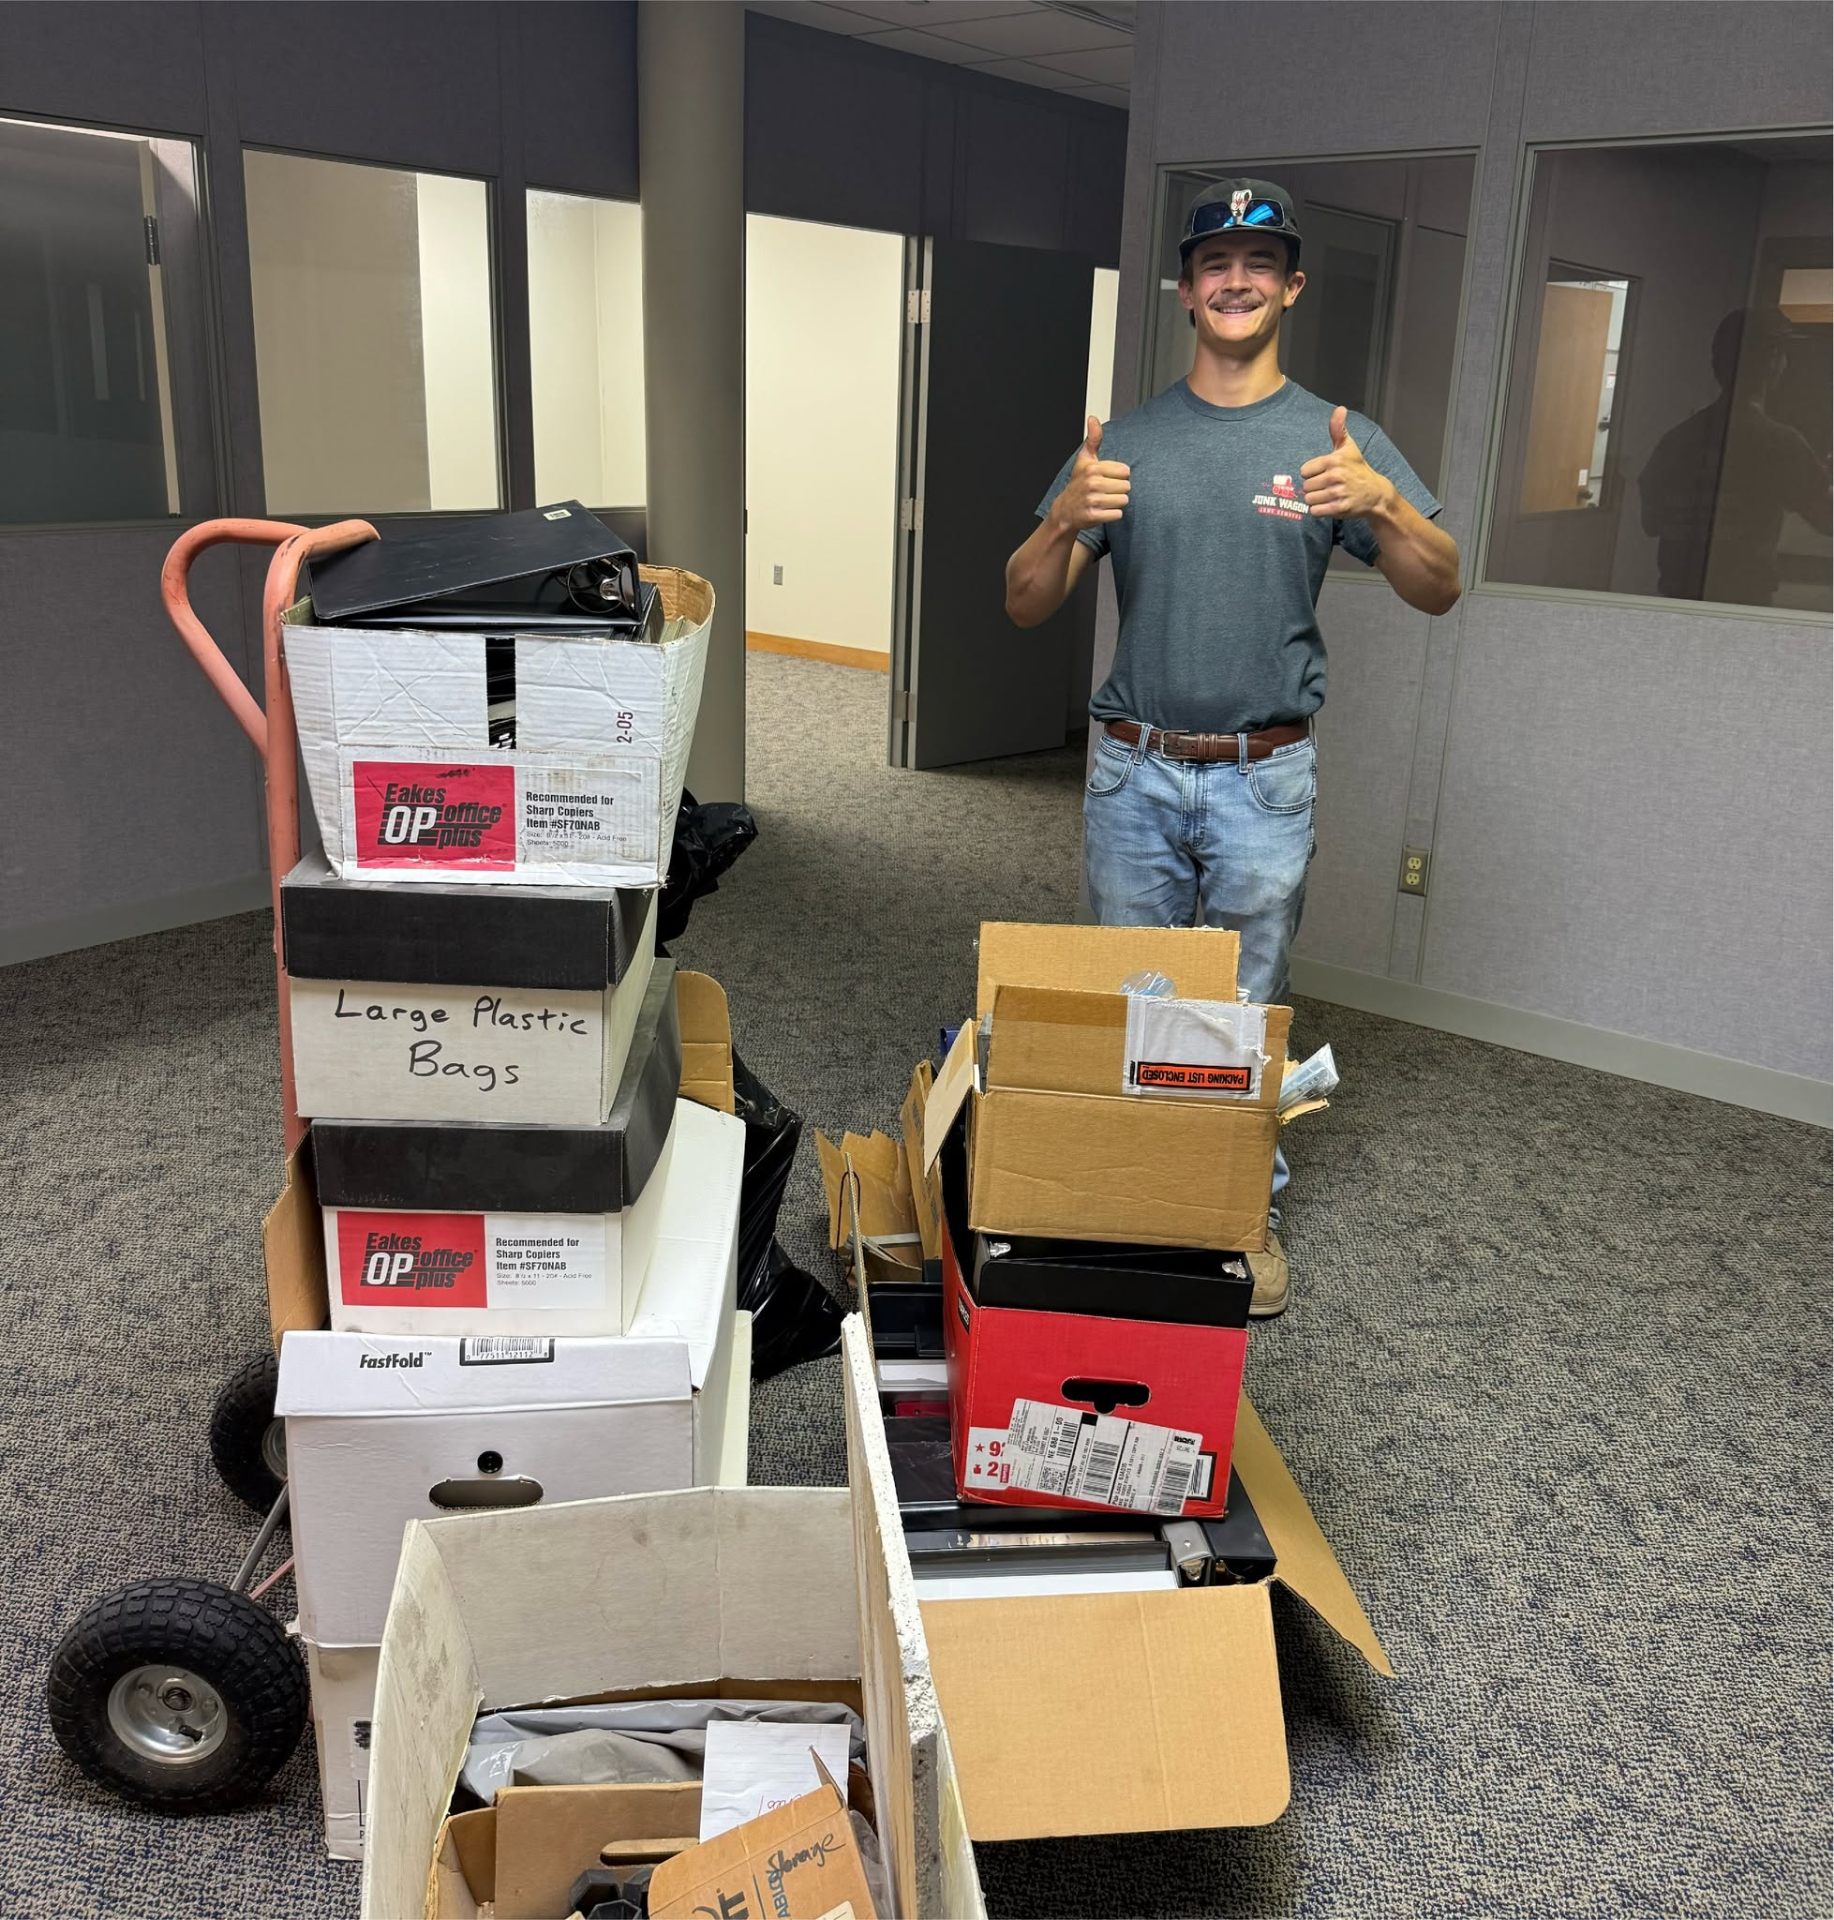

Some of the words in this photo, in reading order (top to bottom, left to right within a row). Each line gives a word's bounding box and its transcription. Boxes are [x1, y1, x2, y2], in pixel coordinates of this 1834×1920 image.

[1252, 495, 1277, 506] JUNK
[1279, 498, 1310, 514] WAGON
[616, 711, 634, 744] 2-05
[384, 783, 447, 804] Eakes
[526, 792, 598, 805] Recommended
[601, 795, 614, 806] for
[526, 805, 555, 817] Sharp
[558, 806, 594, 818] Copiers
[384, 805, 438, 844] OP
[443, 802, 503, 824] office
[526, 818, 548, 829] Item
[551, 820, 600, 831] #SF70NAB
[438, 828, 483, 850] plus
[334, 989, 450, 1033] Large
[472, 995, 588, 1035] Plastic
[409, 1039, 520, 1092] Bags
[1142, 1069, 1185, 1083] ENCLOSED
[1187, 1071, 1205, 1083] LIST
[1207, 1073, 1244, 1085] PACKING
[366, 1232, 423, 1250] Eakes
[496, 1237, 564, 1247] Recommended
[567, 1237, 580, 1247] for
[496, 1249, 523, 1260] Sharp
[526, 1249, 561, 1260] Copiers
[366, 1252, 414, 1285] OP
[420, 1248, 474, 1268] office
[496, 1261, 517, 1271] Item
[520, 1261, 567, 1271] #SF70NAB
[415, 1271, 456, 1290] plus
[509, 1351, 533, 1359] 12112
